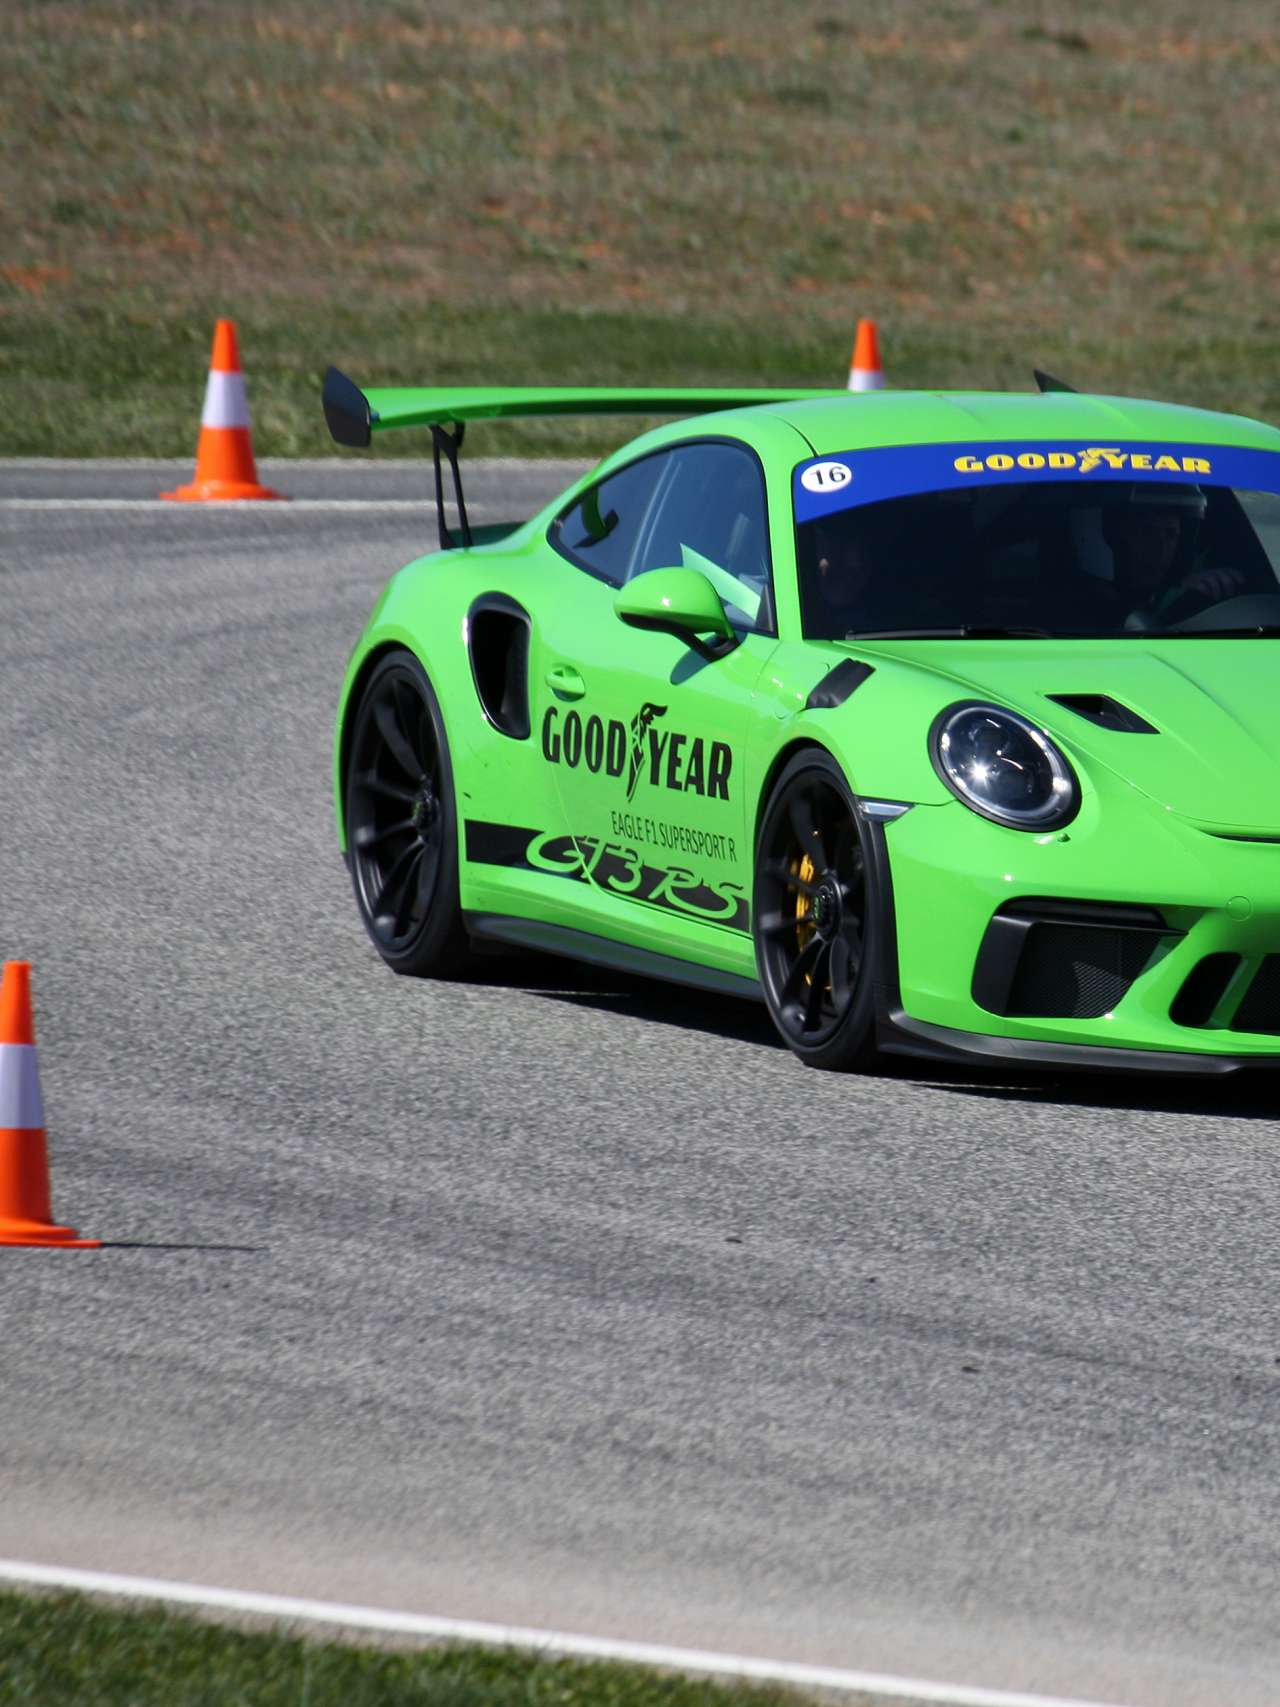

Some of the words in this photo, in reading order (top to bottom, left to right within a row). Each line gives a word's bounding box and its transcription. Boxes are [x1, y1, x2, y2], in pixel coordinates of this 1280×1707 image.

[810, 465, 847, 486] 16
[611, 810, 644, 842] EAGLE
[645, 819, 658, 845] F1
[659, 822, 726, 861] SUPERSPORT
[728, 837, 737, 863] R
